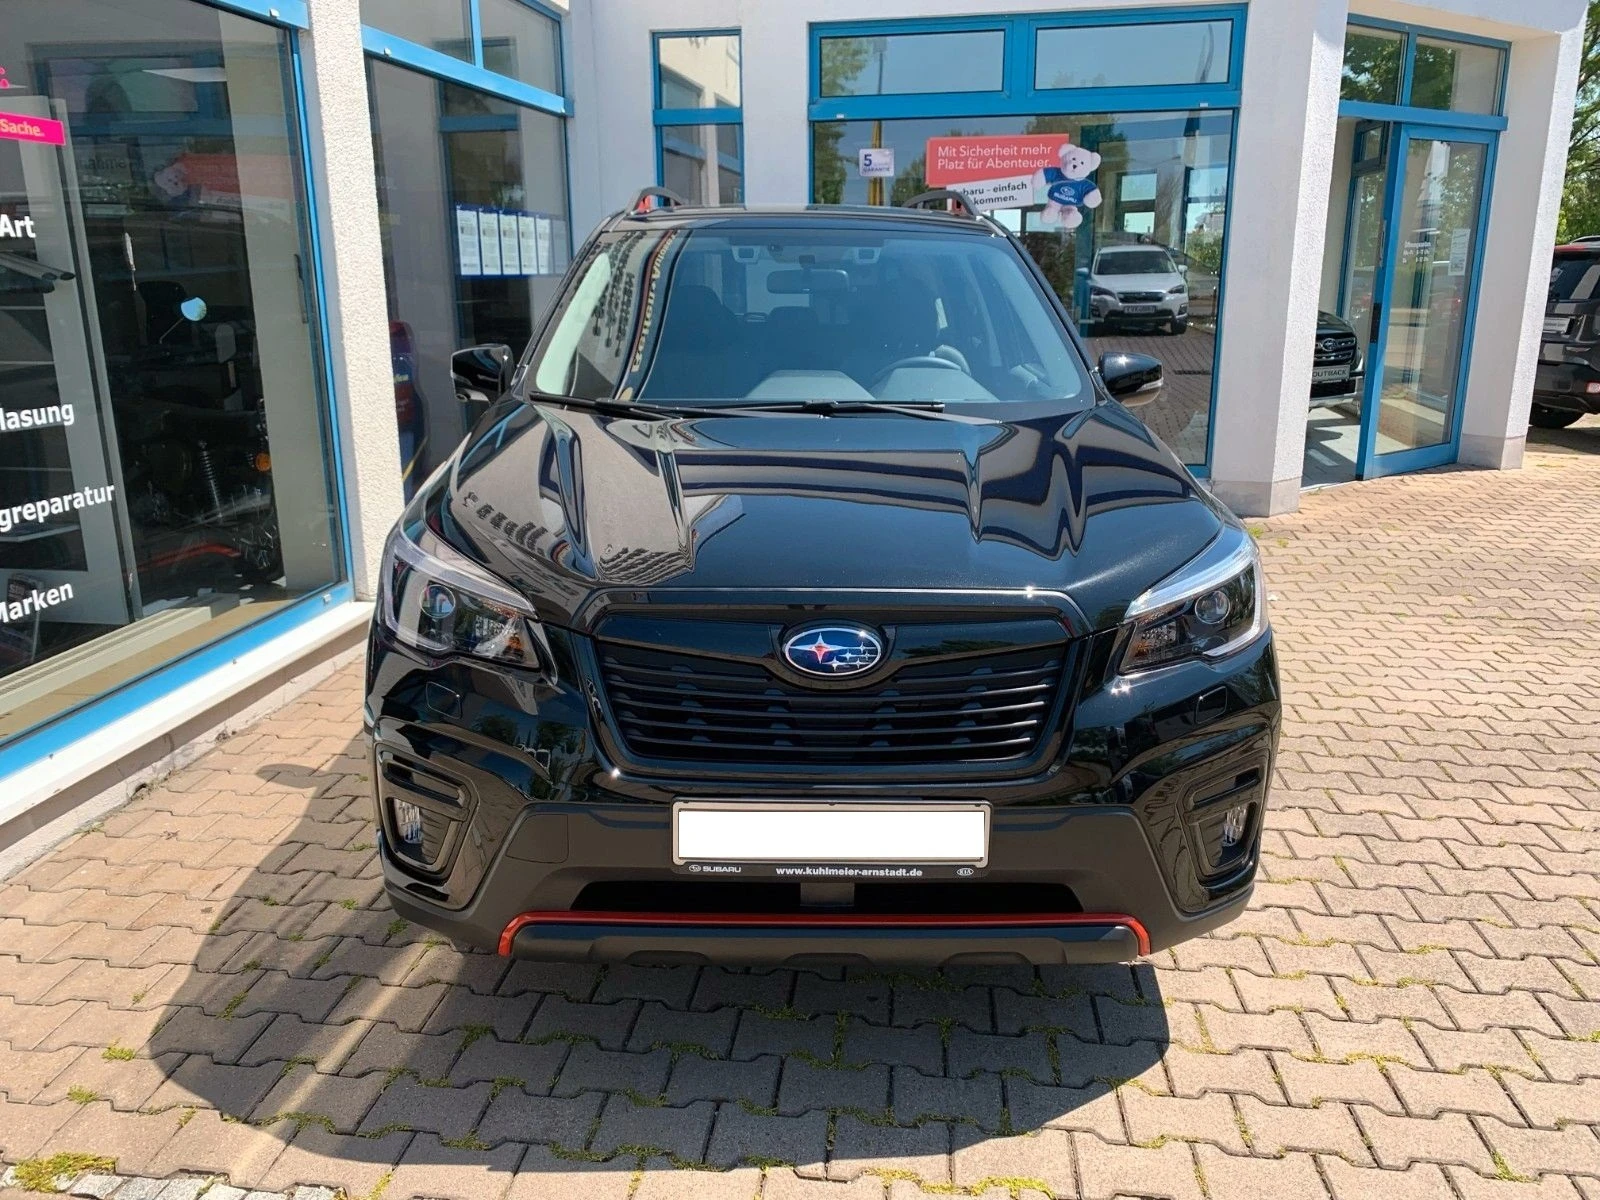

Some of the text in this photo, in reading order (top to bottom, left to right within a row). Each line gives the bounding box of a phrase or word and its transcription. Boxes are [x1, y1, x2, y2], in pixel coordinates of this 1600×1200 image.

[0, 118, 45, 137] Sache.
[937, 143, 1052, 157] Mit Sicherheit mehr
[863, 153, 873, 167] 5
[937, 157, 1052, 170] Platz für Abenteuer.
[992, 182, 1027, 193] einfach
[0, 213, 36, 239] Art
[0, 484, 115, 533] greparatur
[702, 865, 973, 877] SUBARU www.kuhlmeier-arnstadt.de KIA
